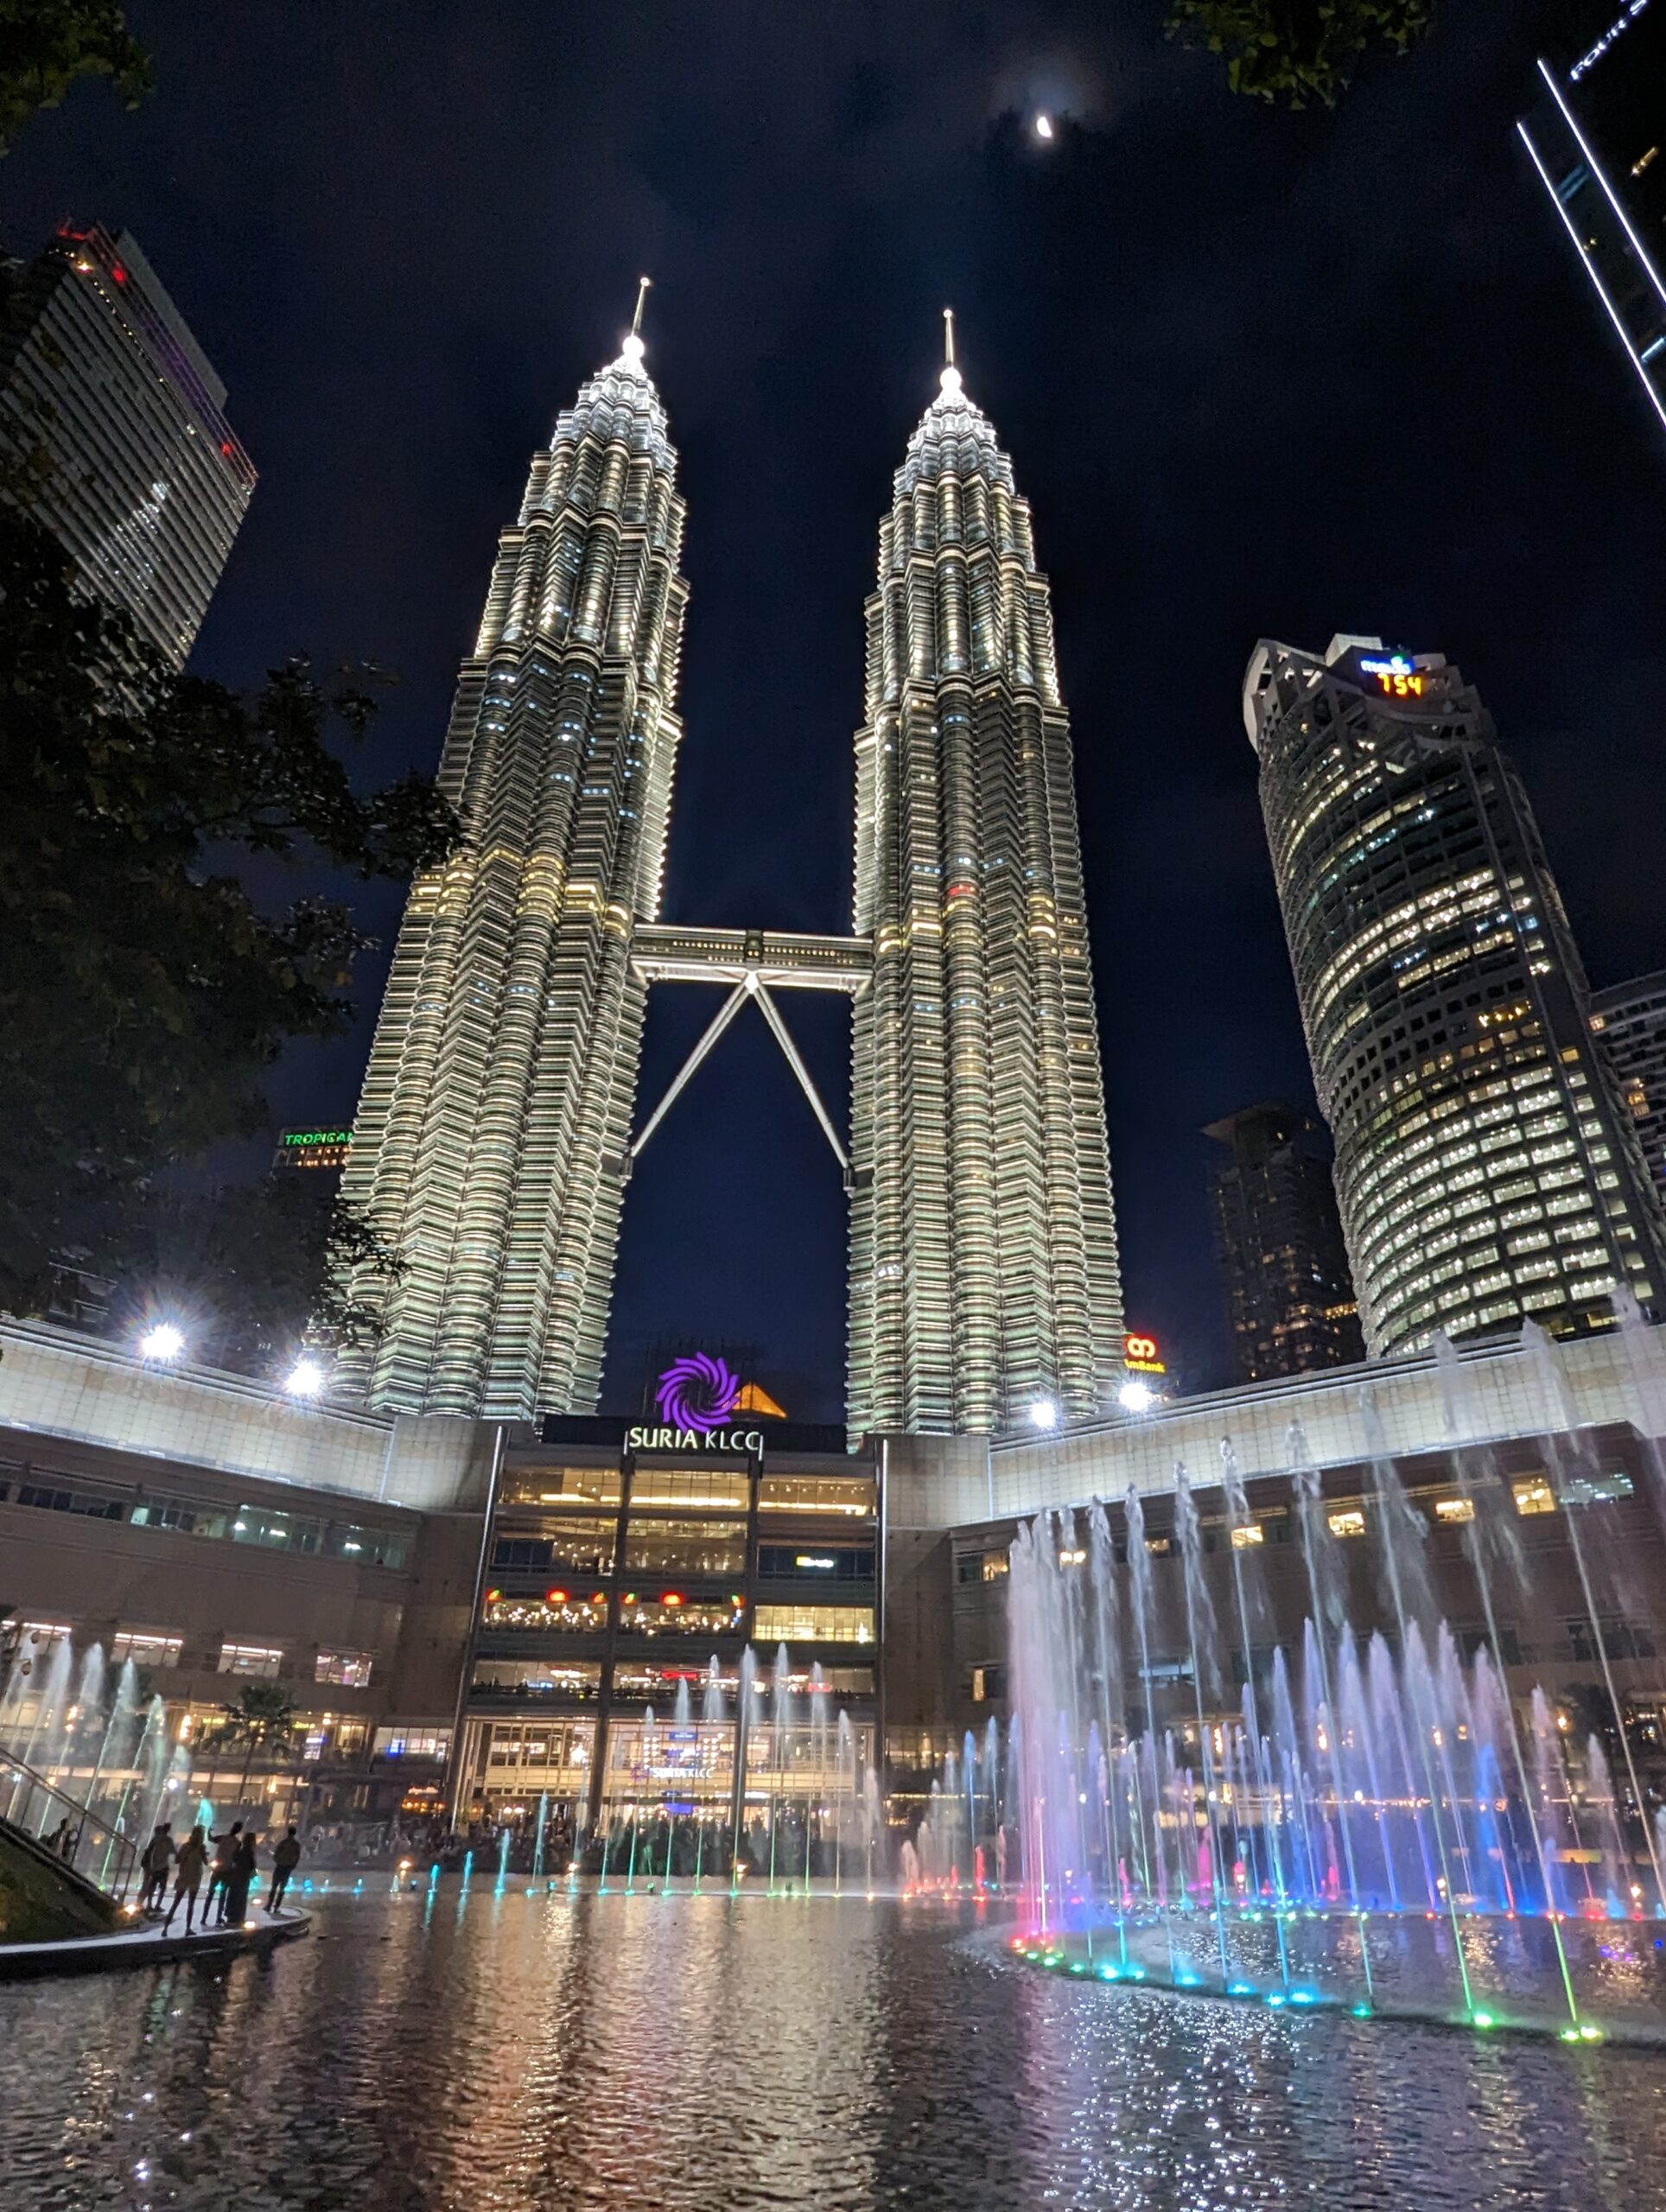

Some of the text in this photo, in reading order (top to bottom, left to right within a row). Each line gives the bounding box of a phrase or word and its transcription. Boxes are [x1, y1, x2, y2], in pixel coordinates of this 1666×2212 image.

[1570, 19, 1626, 80] FOUR
[628, 1427, 760, 1451] SURIA KLCC
[688, 1768, 713, 1778] KLCC
